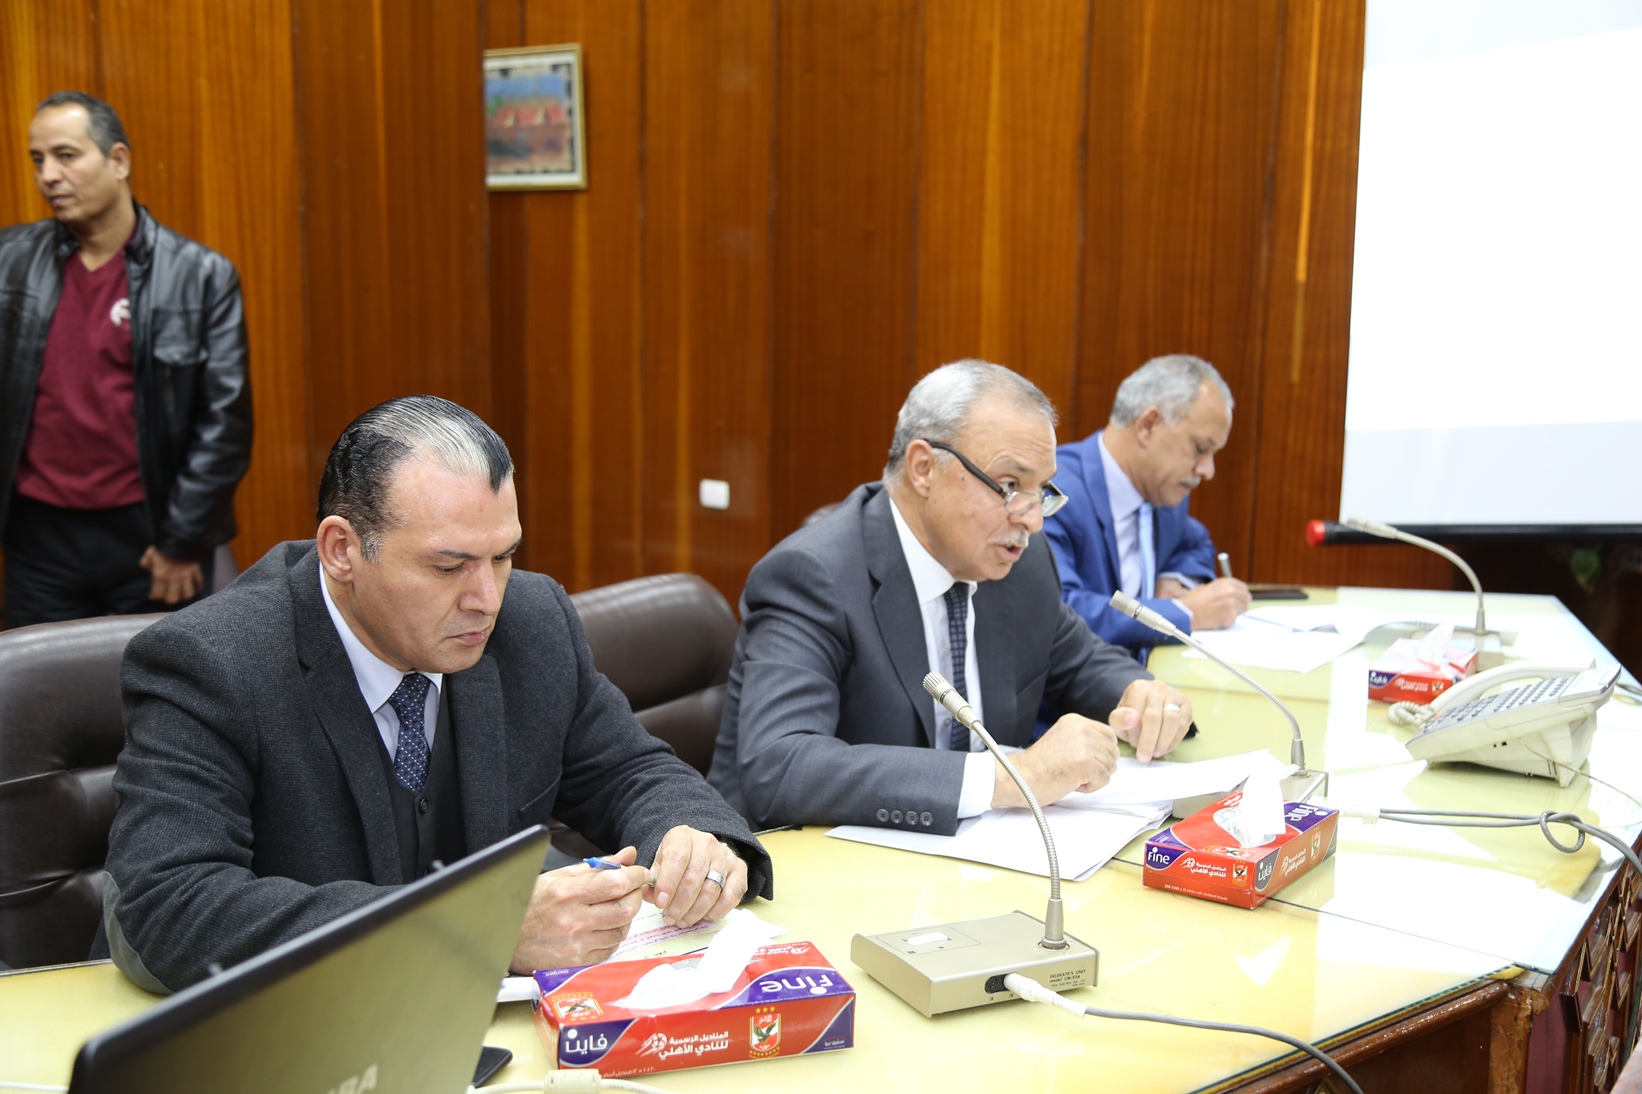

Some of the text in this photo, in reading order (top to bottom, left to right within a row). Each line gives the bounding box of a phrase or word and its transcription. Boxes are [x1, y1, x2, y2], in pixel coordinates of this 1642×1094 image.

[1147, 846, 1171, 865] Fine
[1258, 861, 1273, 881] فاين
[759, 974, 834, 995] Fine
[565, 1028, 609, 1056] فاين
[669, 1030, 729, 1046] المناديل الرسمية
[658, 1044, 694, 1061] الأهلي
[695, 1040, 729, 1057] للنادي
